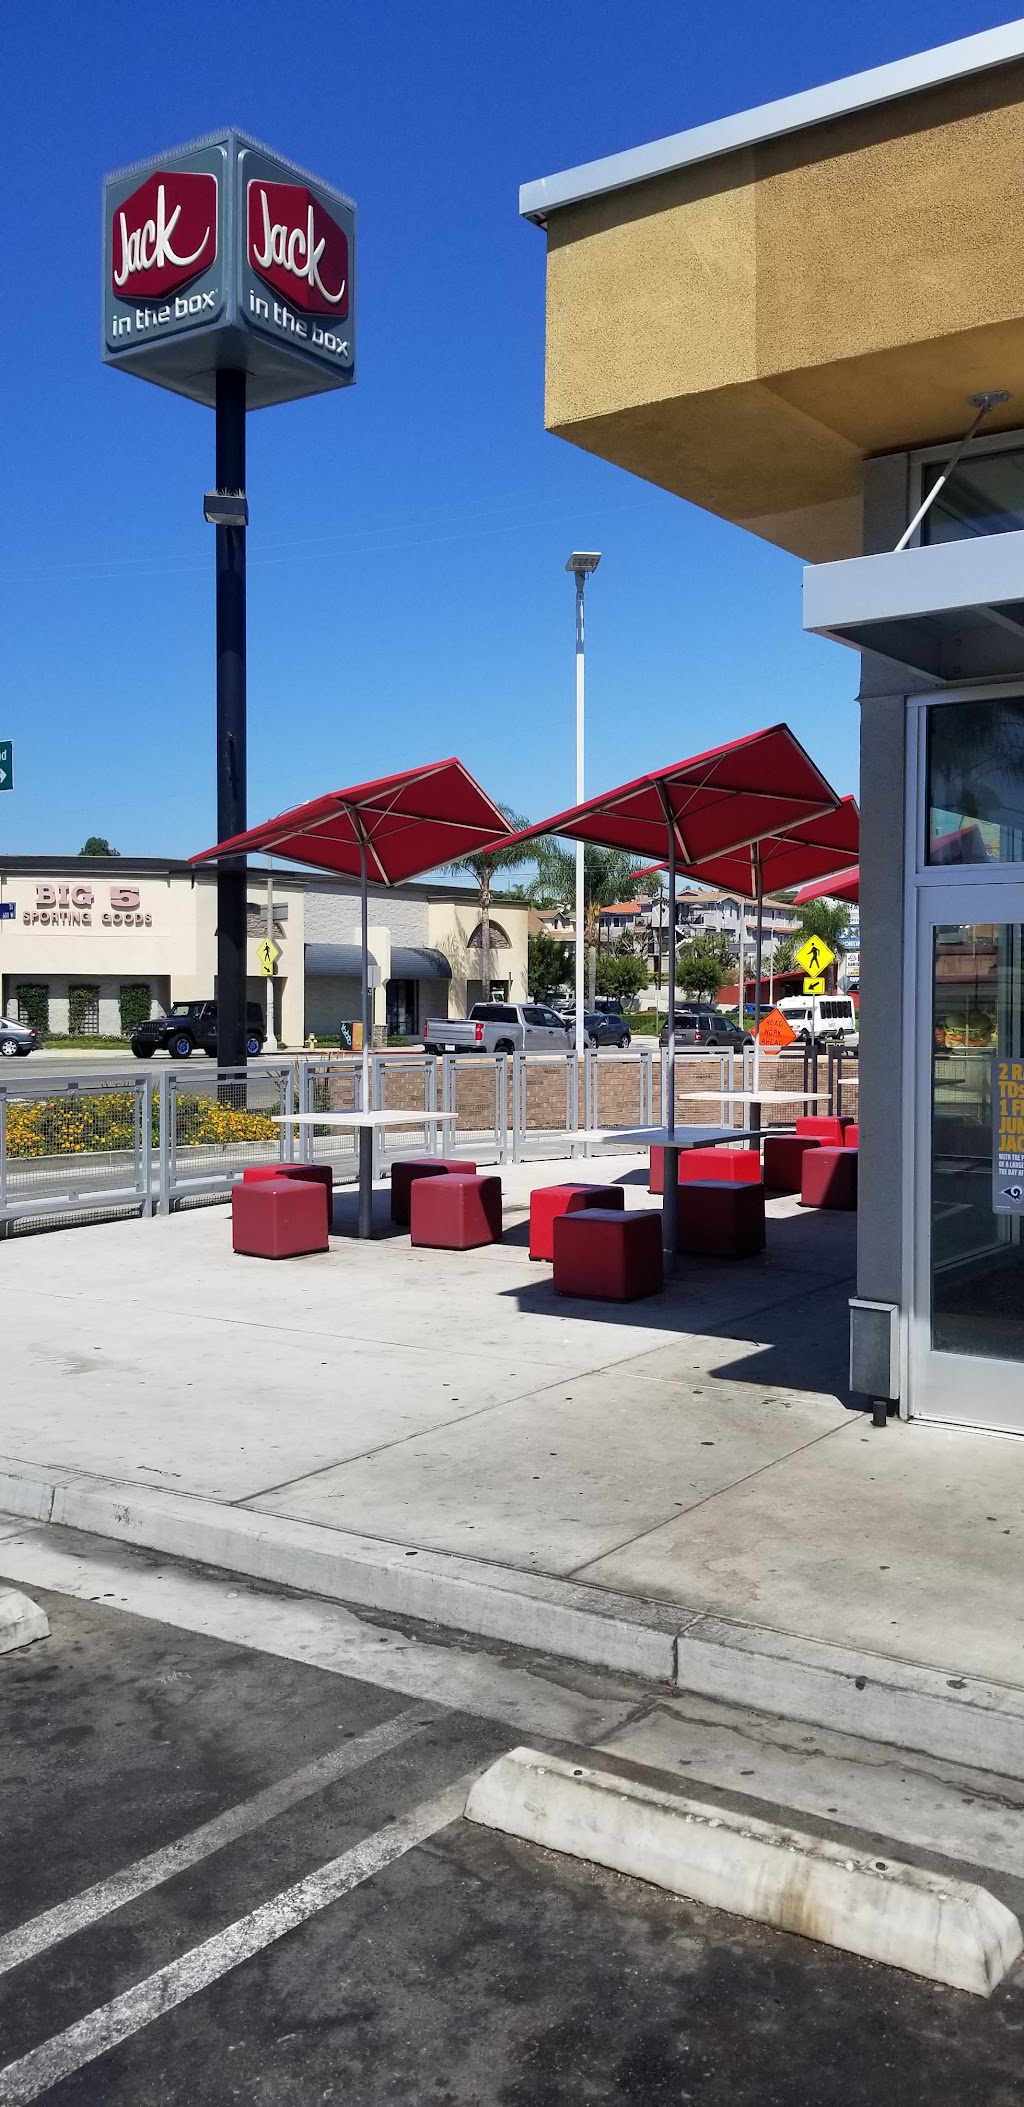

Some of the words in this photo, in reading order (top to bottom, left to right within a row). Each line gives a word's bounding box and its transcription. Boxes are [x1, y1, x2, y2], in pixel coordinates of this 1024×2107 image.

[114, 185, 210, 287] Jack
[254, 189, 346, 303] Jack
[113, 315, 131, 336] in
[136, 306, 170, 329] the
[175, 290, 215, 318] box
[250, 289, 268, 318] in
[274, 302, 307, 338] the
[312, 322, 348, 357] box
[36, 884, 94, 910] BIG
[110, 886, 140, 912] 5
[23, 911, 92, 927] SPORTING
[102, 912, 152, 928] GOODS
[766, 1019, 783, 1028] ROAD
[761, 1038, 784, 1046] AHEAD
[764, 1028, 782, 1038] WORK
[999, 1062, 1008, 1080] 2
[1011, 1063, 1024, 1081] R
[1000, 1098, 1008, 1116] 1
[1008, 1168, 1017, 1176] DAY
